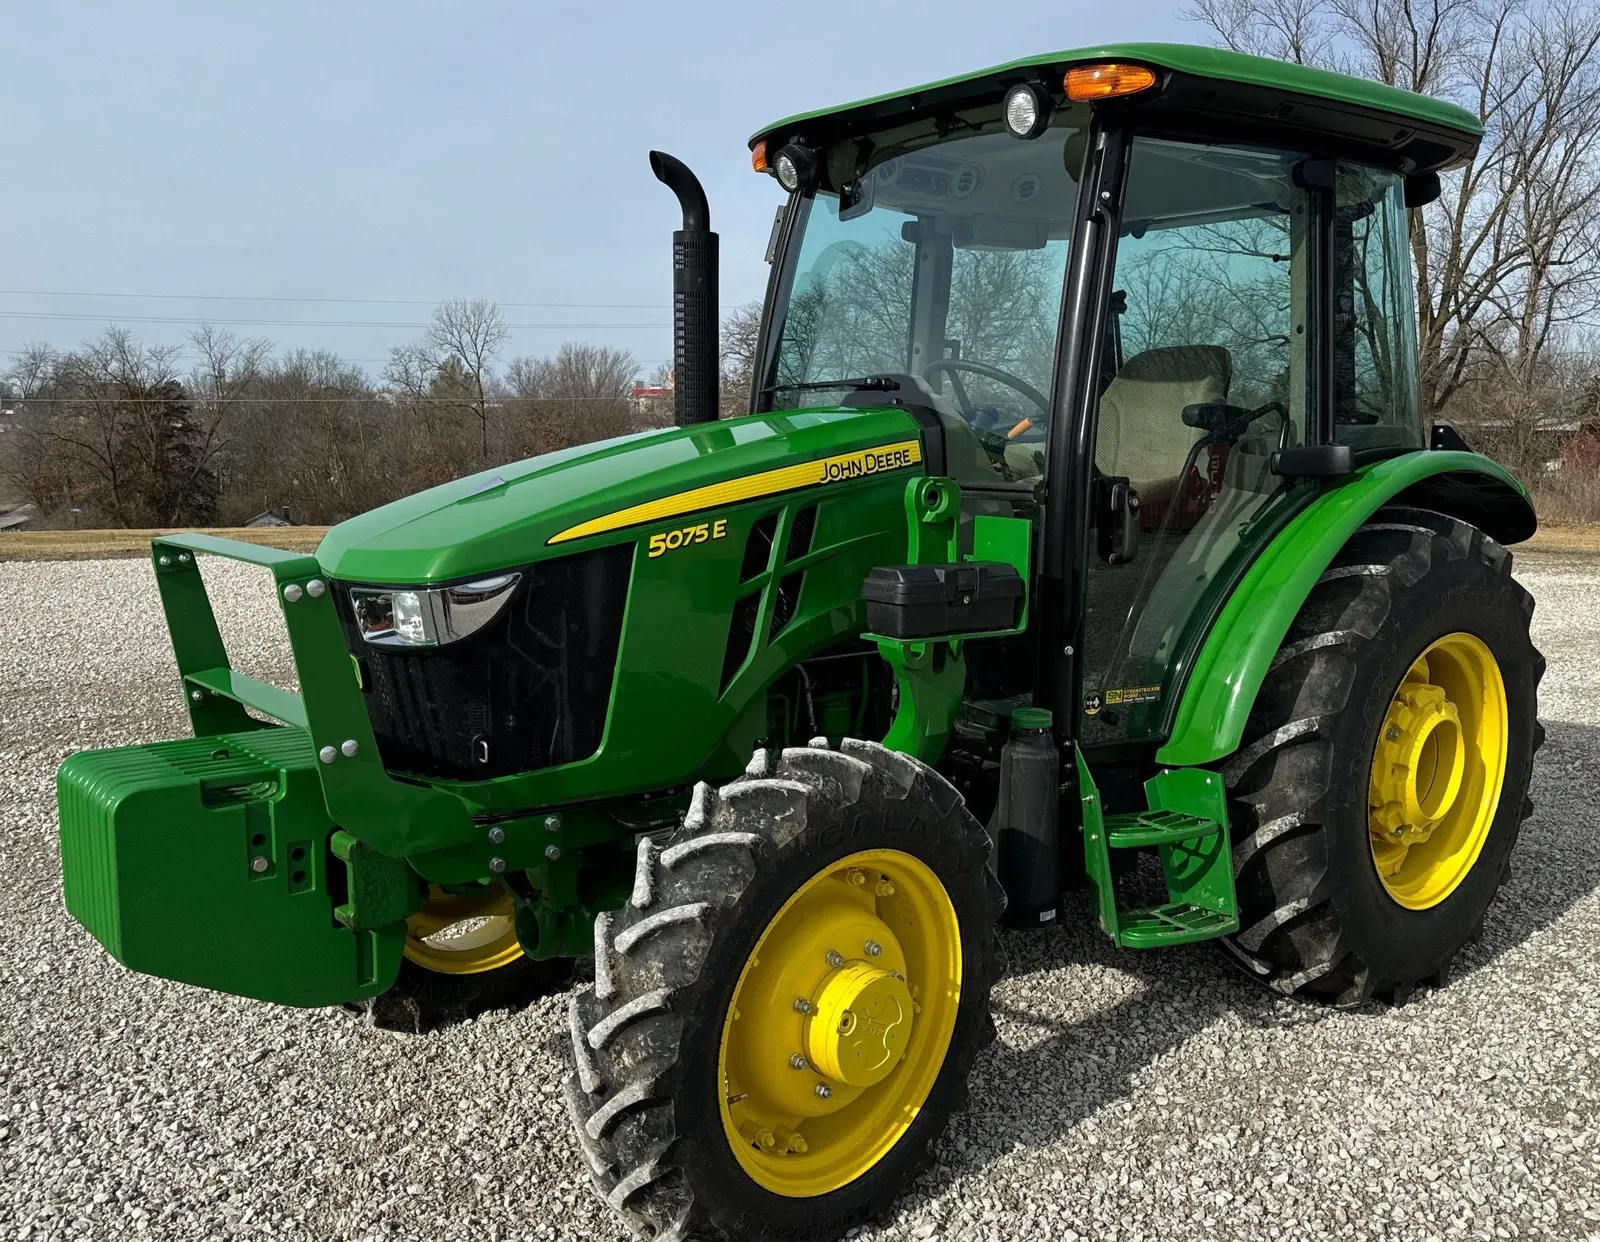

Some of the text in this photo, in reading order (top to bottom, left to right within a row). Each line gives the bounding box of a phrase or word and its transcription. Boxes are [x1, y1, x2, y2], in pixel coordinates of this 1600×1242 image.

[820, 449, 911, 484] JOHN DEERE
[648, 518, 728, 558] 5075 E
[1107, 690, 1122, 700] SN
